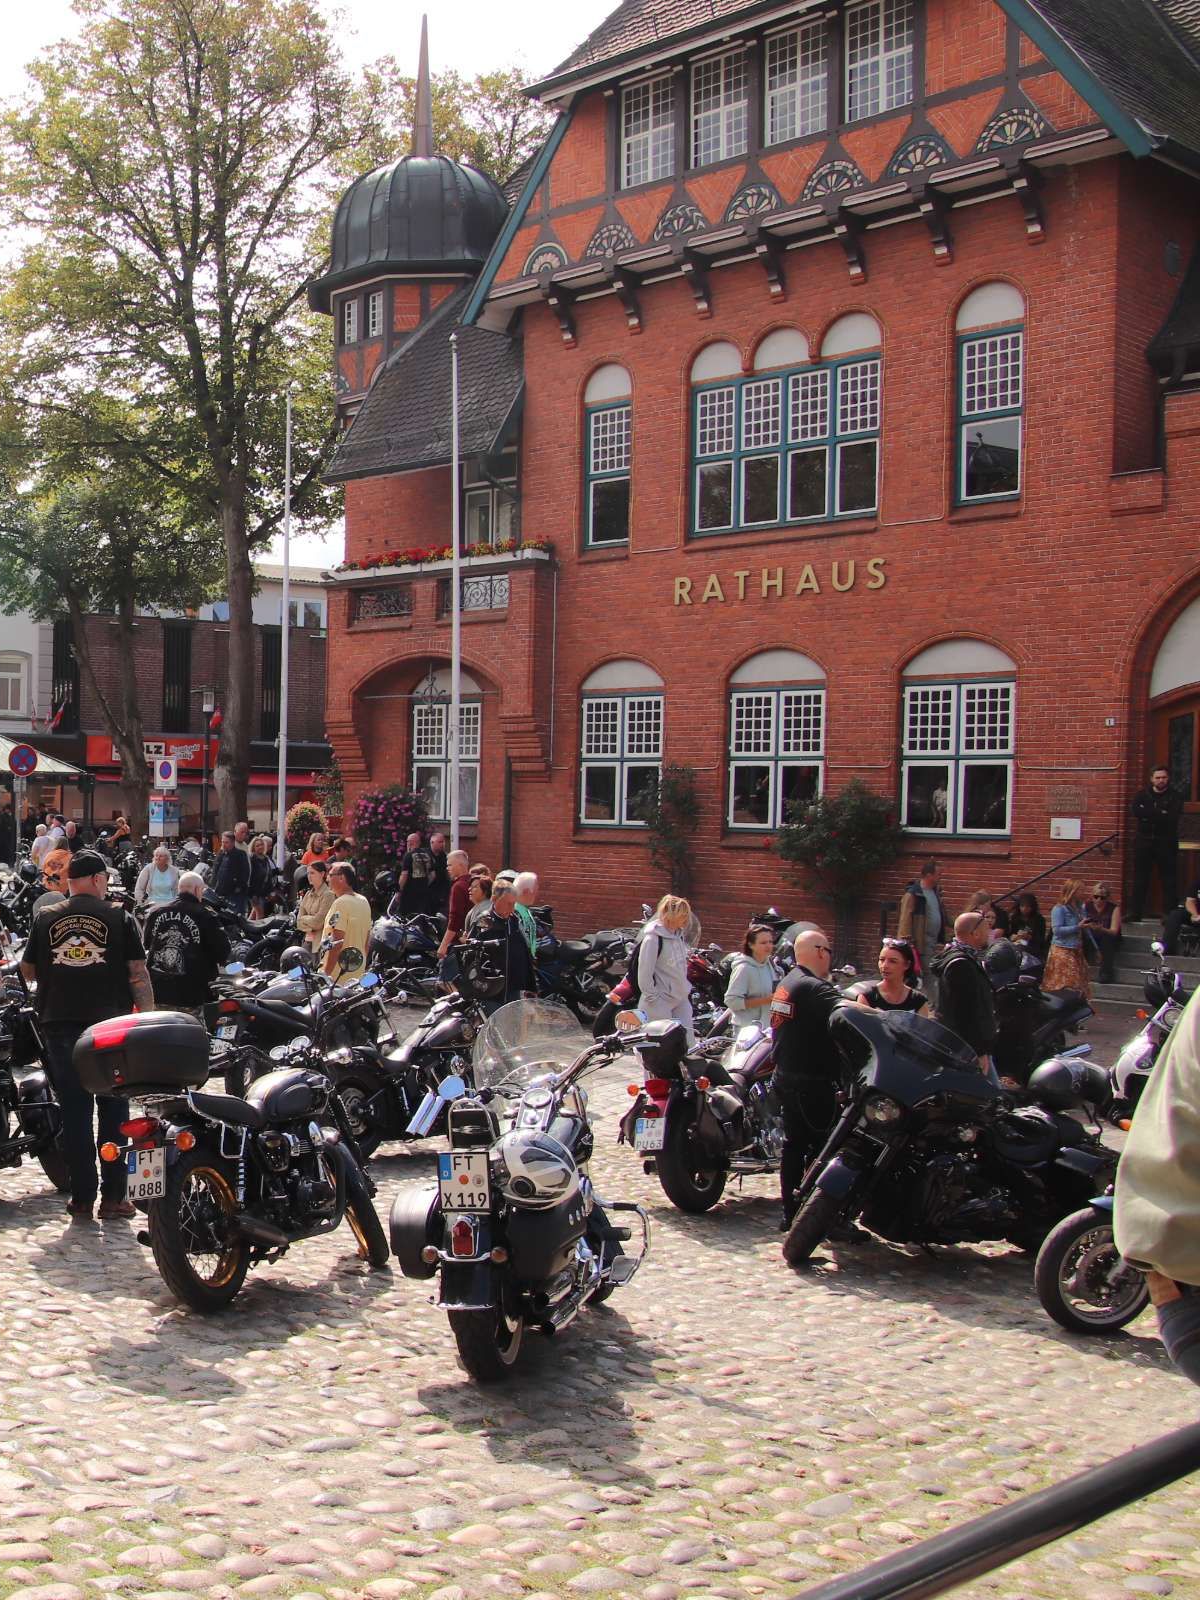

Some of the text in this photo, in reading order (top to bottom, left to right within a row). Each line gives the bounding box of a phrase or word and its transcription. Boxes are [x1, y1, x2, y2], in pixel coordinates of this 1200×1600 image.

[673, 557, 887, 607] RATHAUS
[79, 917, 102, 929] CHAPTER
[82, 923, 105, 938] GERMANY
[182, 914, 201, 945] BIKER
[138, 1150, 155, 1165] FT
[453, 1155, 474, 1171] FT
[128, 1181, 162, 1198] W 888
[443, 1192, 487, 1208] X 119
